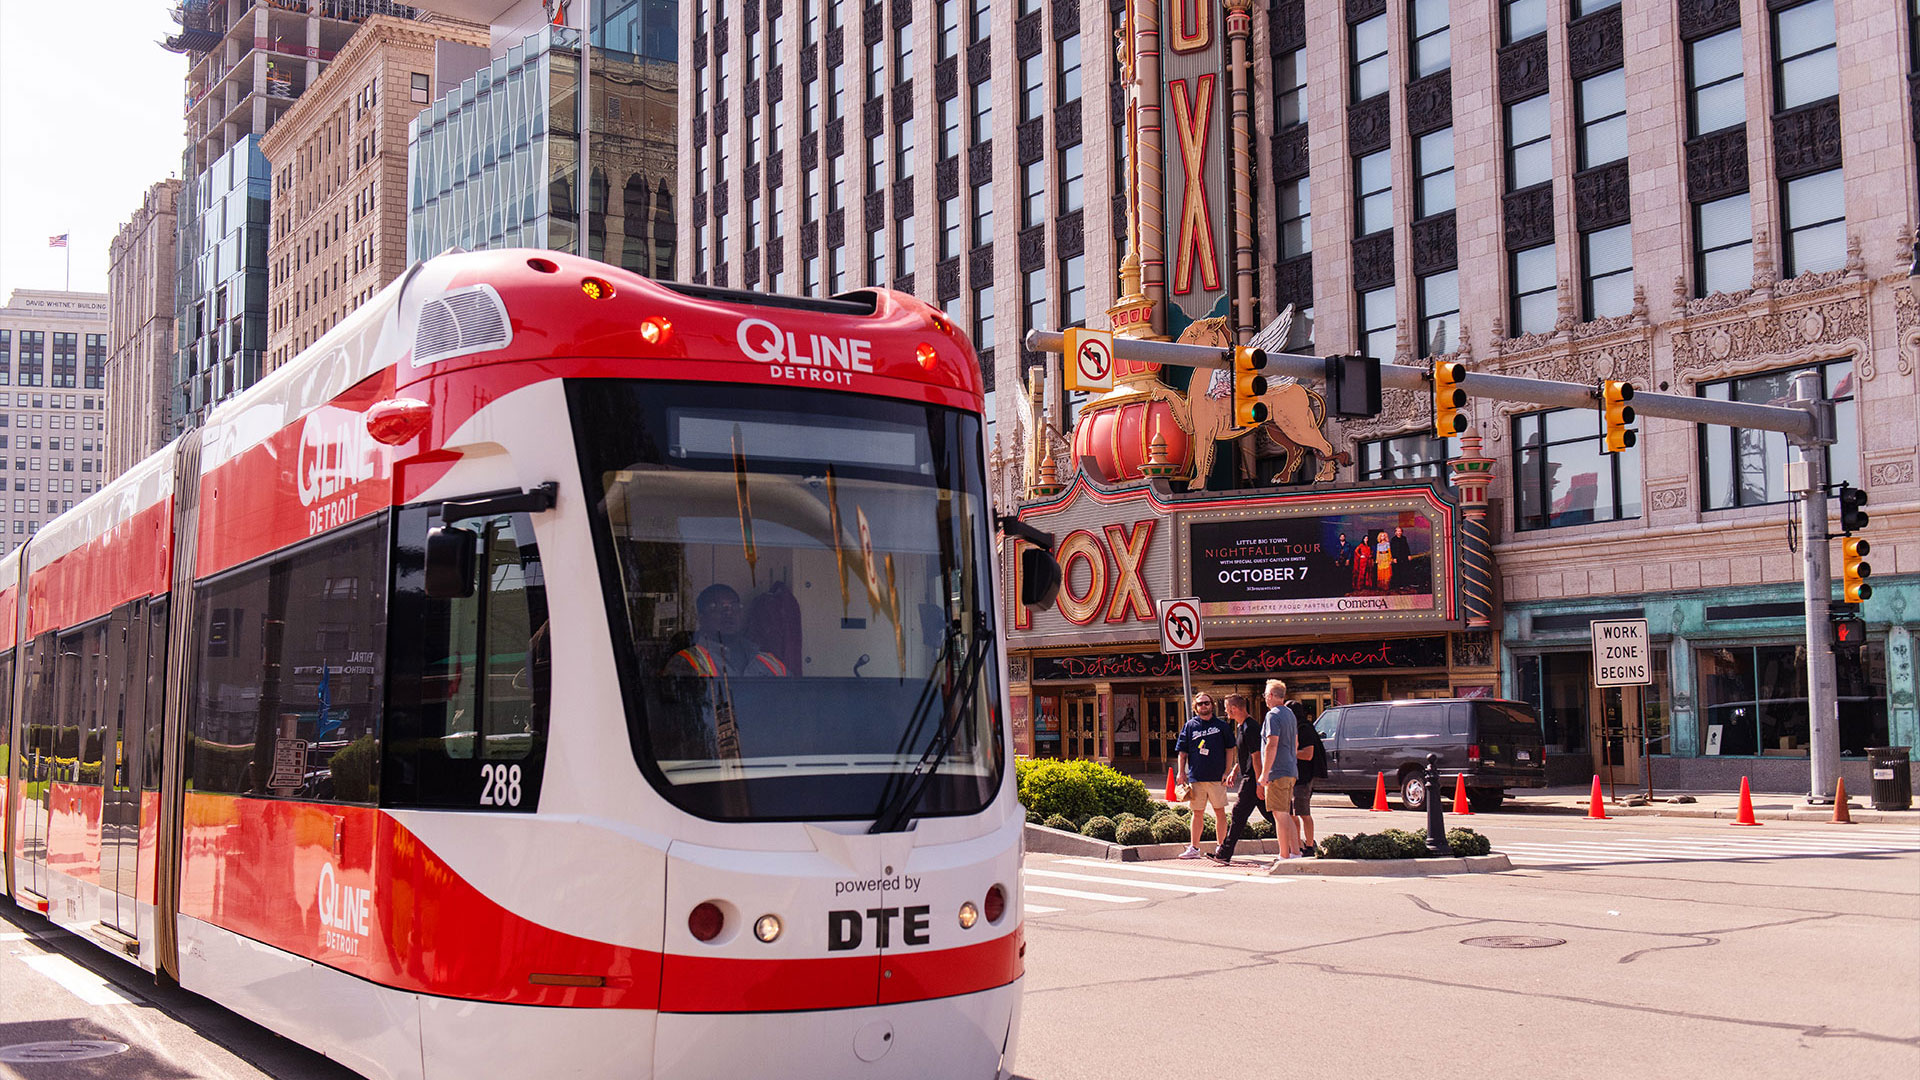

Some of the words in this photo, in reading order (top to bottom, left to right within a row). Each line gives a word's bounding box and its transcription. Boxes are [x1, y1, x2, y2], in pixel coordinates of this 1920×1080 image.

[26, 299, 45, 307] DAVID
[736, 318, 874, 373] QLINE
[770, 365, 853, 385] DETROIT
[298, 411, 375, 507] QLINE
[309, 492, 359, 536] DETROIT
[1205, 545, 1280, 558] NIGHTFALL
[1284, 543, 1321, 554] TOUR
[1218, 567, 1294, 584] OCTOBER
[1299, 566, 1309, 580] 7
[1603, 626, 1638, 639] WORK
[1062, 655, 1147, 675] Detroit's
[1228, 642, 1395, 671] Entertainment
[1606, 646, 1638, 659] ZONE
[1601, 665, 1645, 679] BEGINS
[480, 763, 522, 807] 288
[835, 876, 900, 897] powered
[905, 875, 921, 893] by
[318, 861, 371, 937] QLINE
[828, 904, 930, 951] DTE
[326, 930, 359, 957] DETROIT
